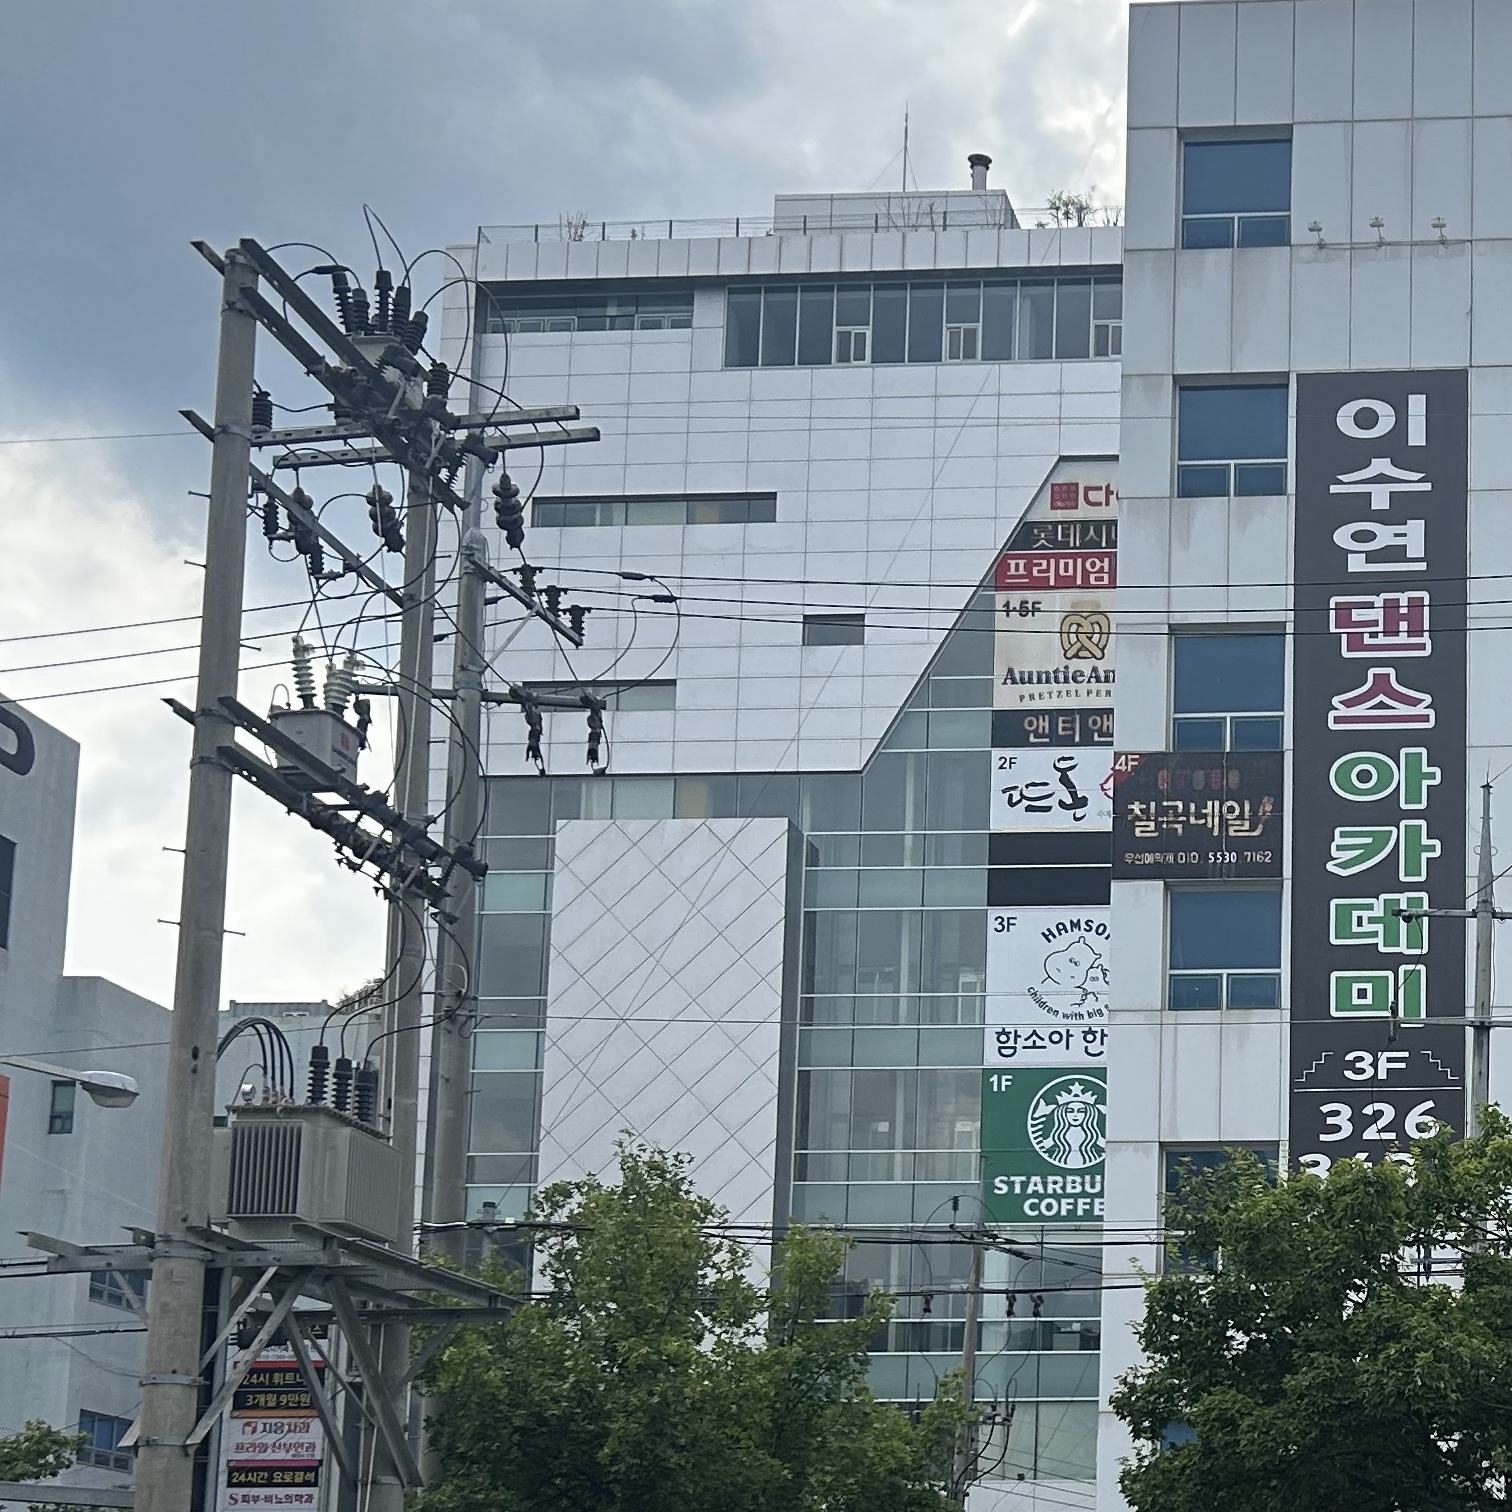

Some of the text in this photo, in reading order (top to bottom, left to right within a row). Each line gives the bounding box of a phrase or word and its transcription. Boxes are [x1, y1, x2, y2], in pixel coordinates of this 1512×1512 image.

[1083, 483, 1119, 507] 다
[1004, 557, 1110, 587] 프리미엄
[1019, 688, 1081, 702] PRETZEL
[998, 756, 1018, 770] 2F
[1114, 754, 1140, 772] 4F
[1127, 800, 1264, 838] 칠곡네일
[993, 915, 1017, 932] 3F
[1027, 986, 1060, 1017] children
[1062, 1010, 1084, 1020] with
[995, 1027, 1075, 1058] 함소아
[1343, 1050, 1410, 1080] 3F
[989, 1074, 1013, 1092] 1F
[1318, 1099, 1441, 1142] 326
[231, 1470, 269, 1483] 24시간
